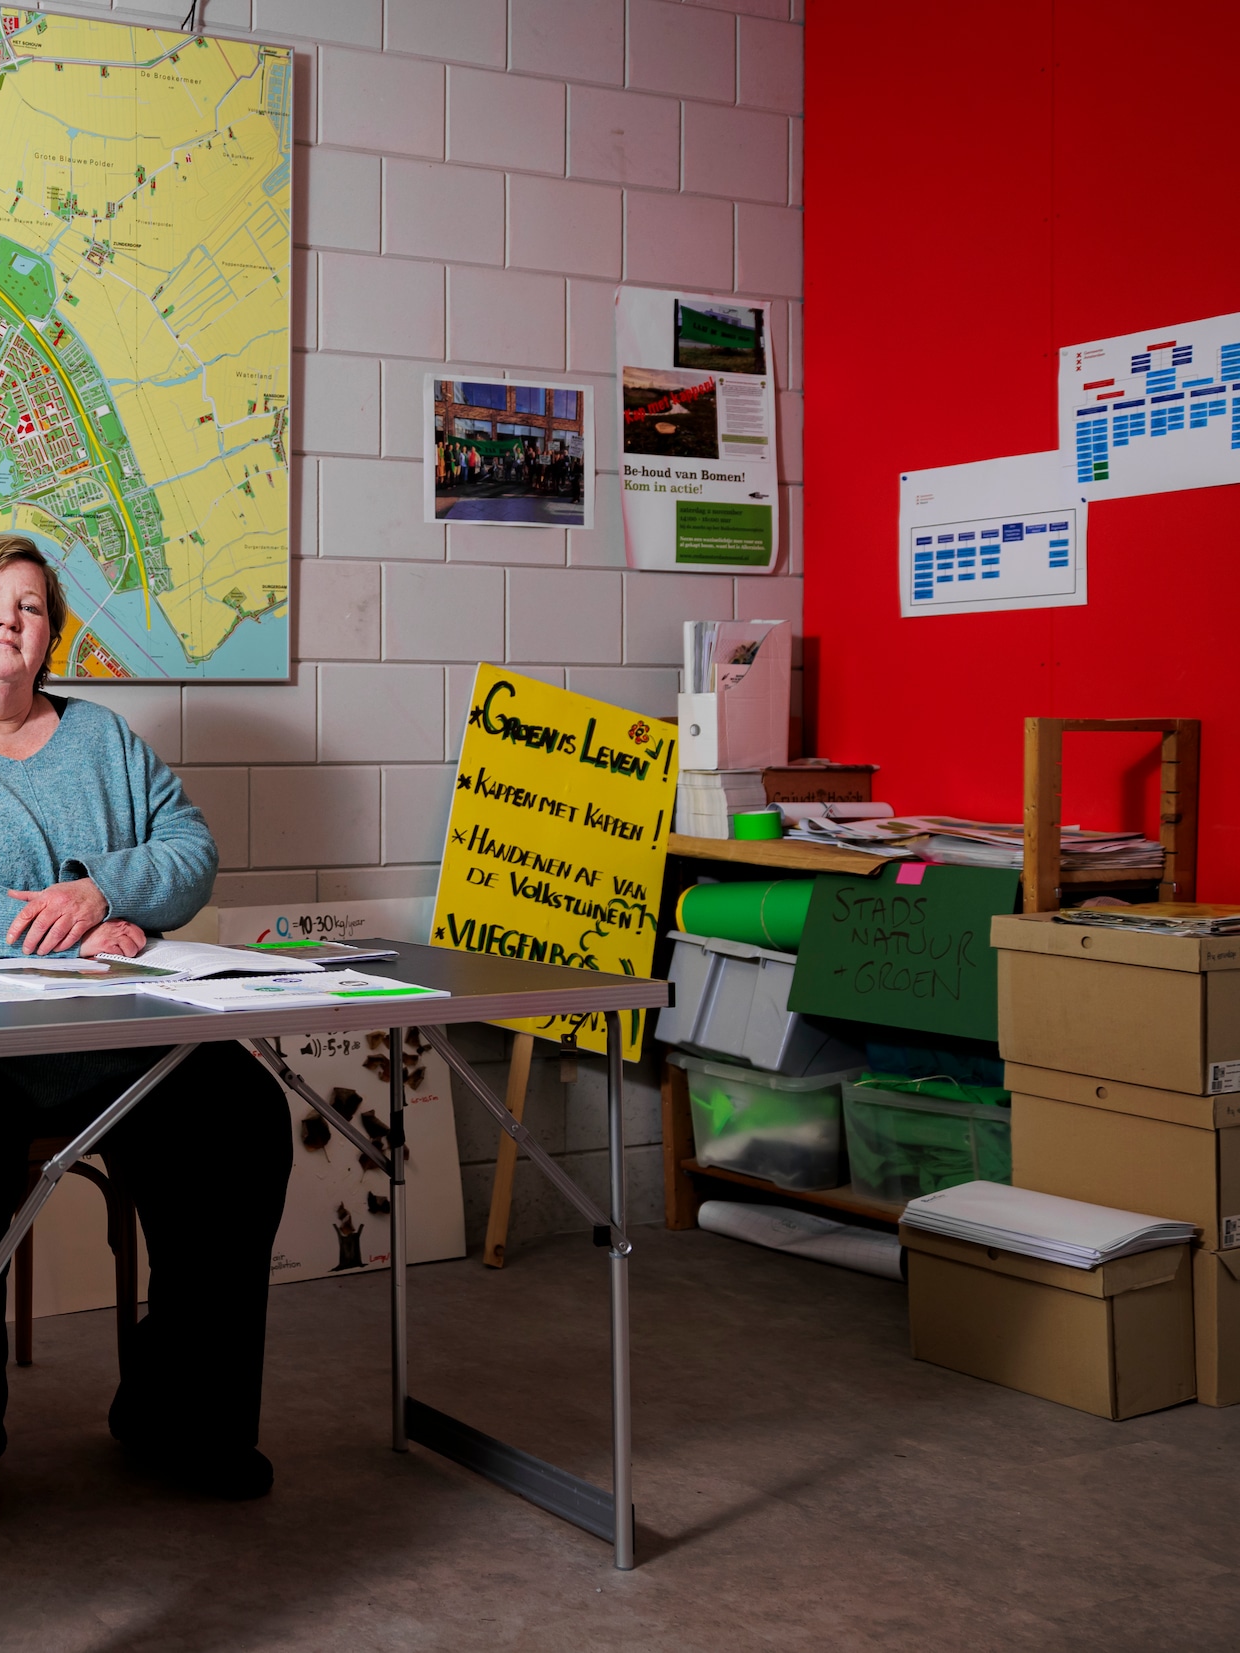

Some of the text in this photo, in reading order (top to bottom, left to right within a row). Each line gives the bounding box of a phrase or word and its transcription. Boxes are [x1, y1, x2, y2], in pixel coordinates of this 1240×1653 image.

[140, 70, 202, 85] De Broekermeer
[34, 152, 115, 168] Grote Blauwe Polder
[235, 371, 272, 380] Waterland
[624, 375, 716, 425] Kap met kappen!
[623, 464, 746, 483] Be-houd van Bomen!
[623, 479, 703, 494] Kom in actie!
[474, 767, 539, 810] KAPPEN
[538, 796, 580, 823] MET
[583, 802, 645, 842] KAPPEN
[466, 867, 500, 889] DE
[574, 866, 604, 888] AF
[613, 875, 648, 901] VAN
[832, 886, 929, 929] STADS
[851, 926, 977, 968] NATUUR
[854, 960, 963, 1001] GROEN
[272, 1251, 287, 1262] air
